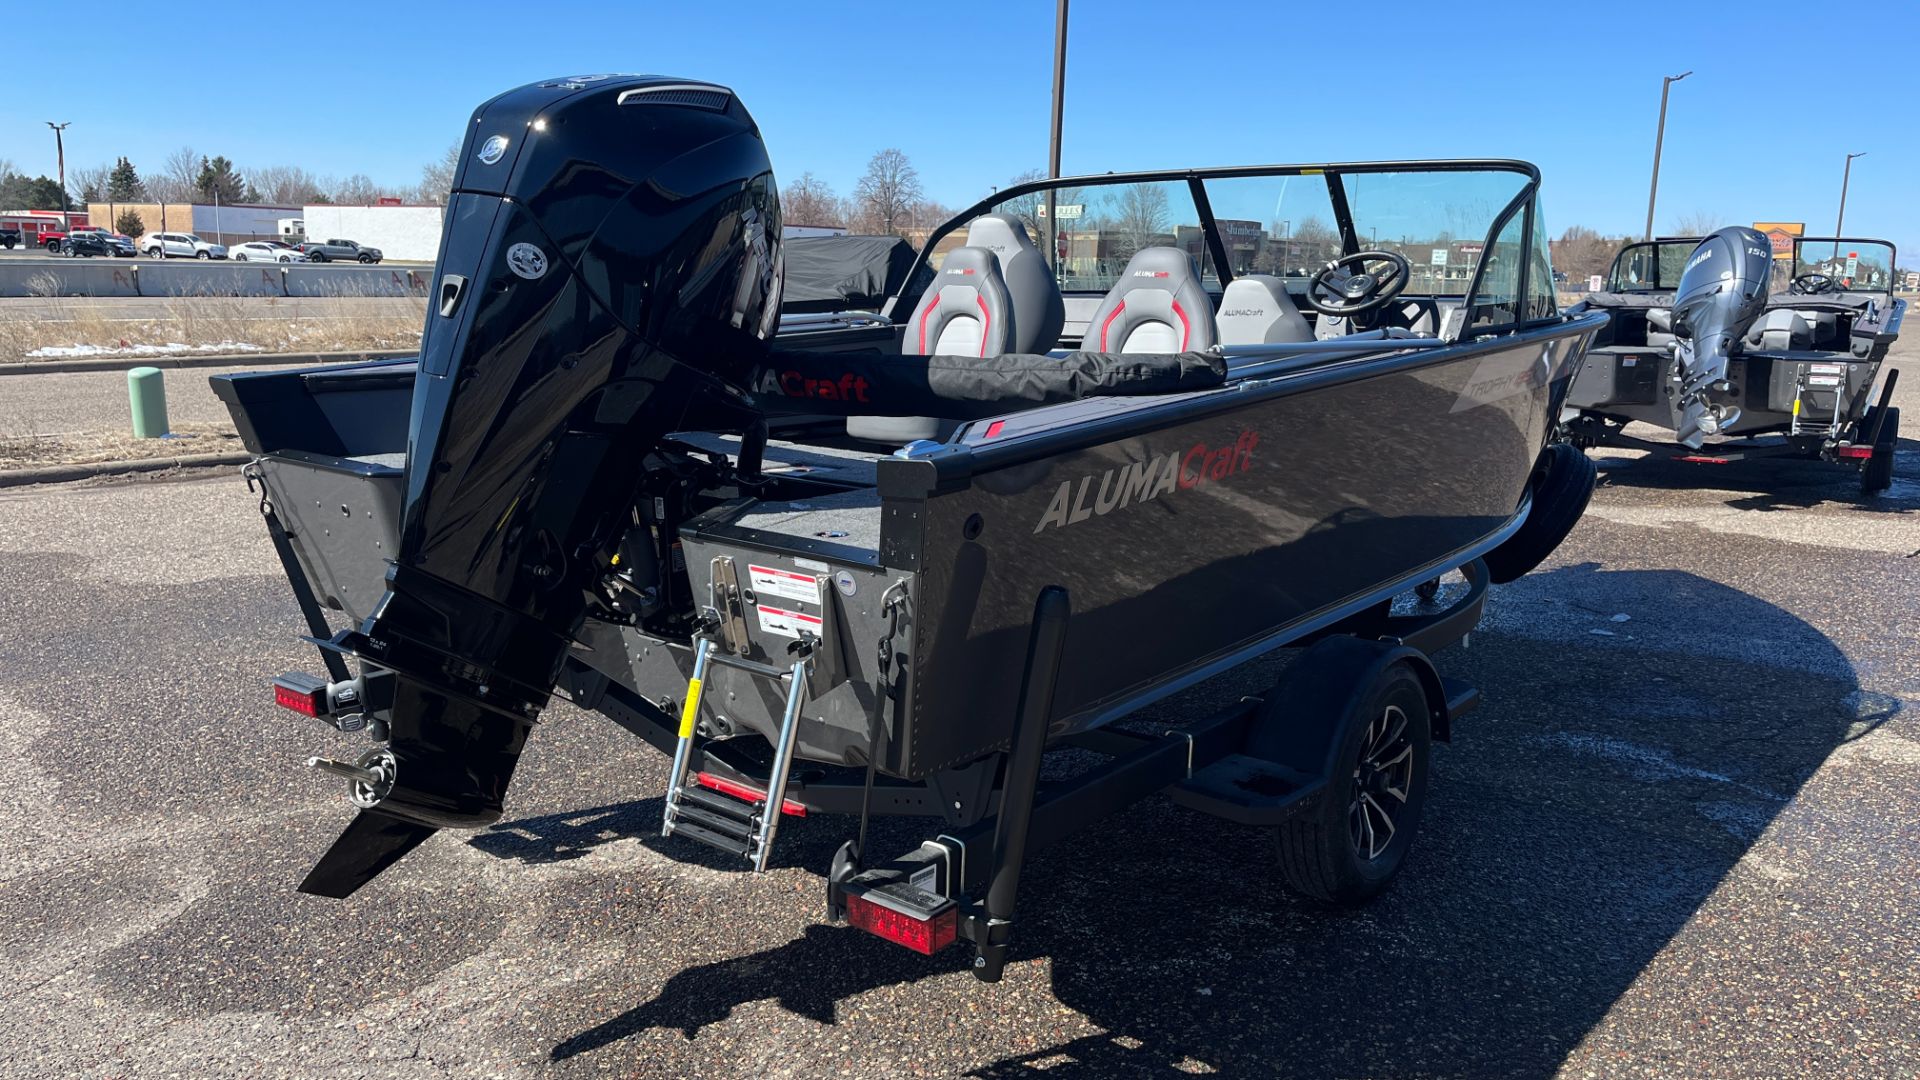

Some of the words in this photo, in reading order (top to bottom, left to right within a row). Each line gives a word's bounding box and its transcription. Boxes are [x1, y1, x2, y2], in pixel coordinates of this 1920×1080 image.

[1747, 247, 1767, 258] 150
[1223, 309, 1264, 317] ALUMACraft
[1033, 430, 1259, 534] ALUMACraft
